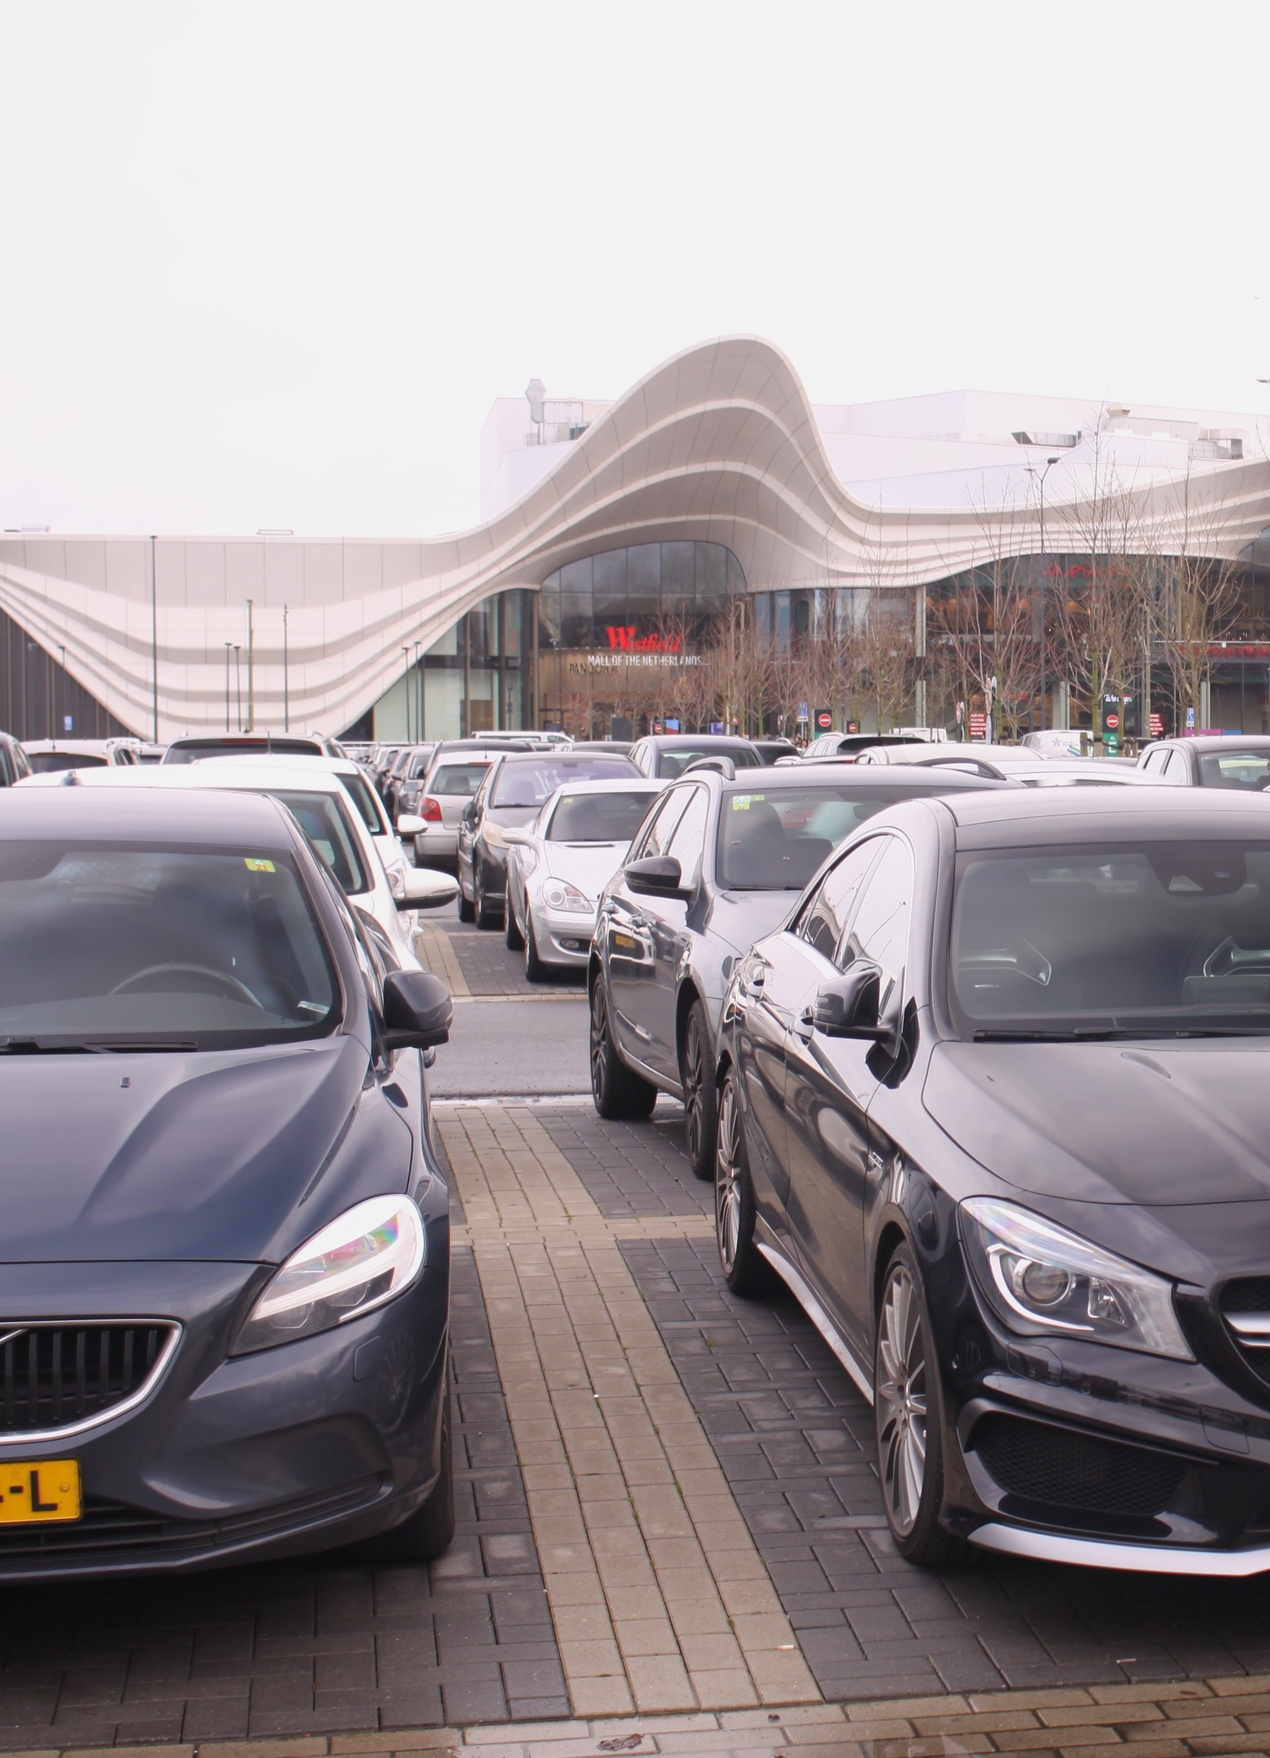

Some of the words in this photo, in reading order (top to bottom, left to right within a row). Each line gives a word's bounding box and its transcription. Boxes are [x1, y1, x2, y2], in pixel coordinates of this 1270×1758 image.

[606, 626, 683, 653] Westfield
[587, 655, 610, 666] MALL
[611, 655, 623, 666] OF
[625, 655, 641, 666] THE
[642, 655, 702, 667] NETHERLANDS
